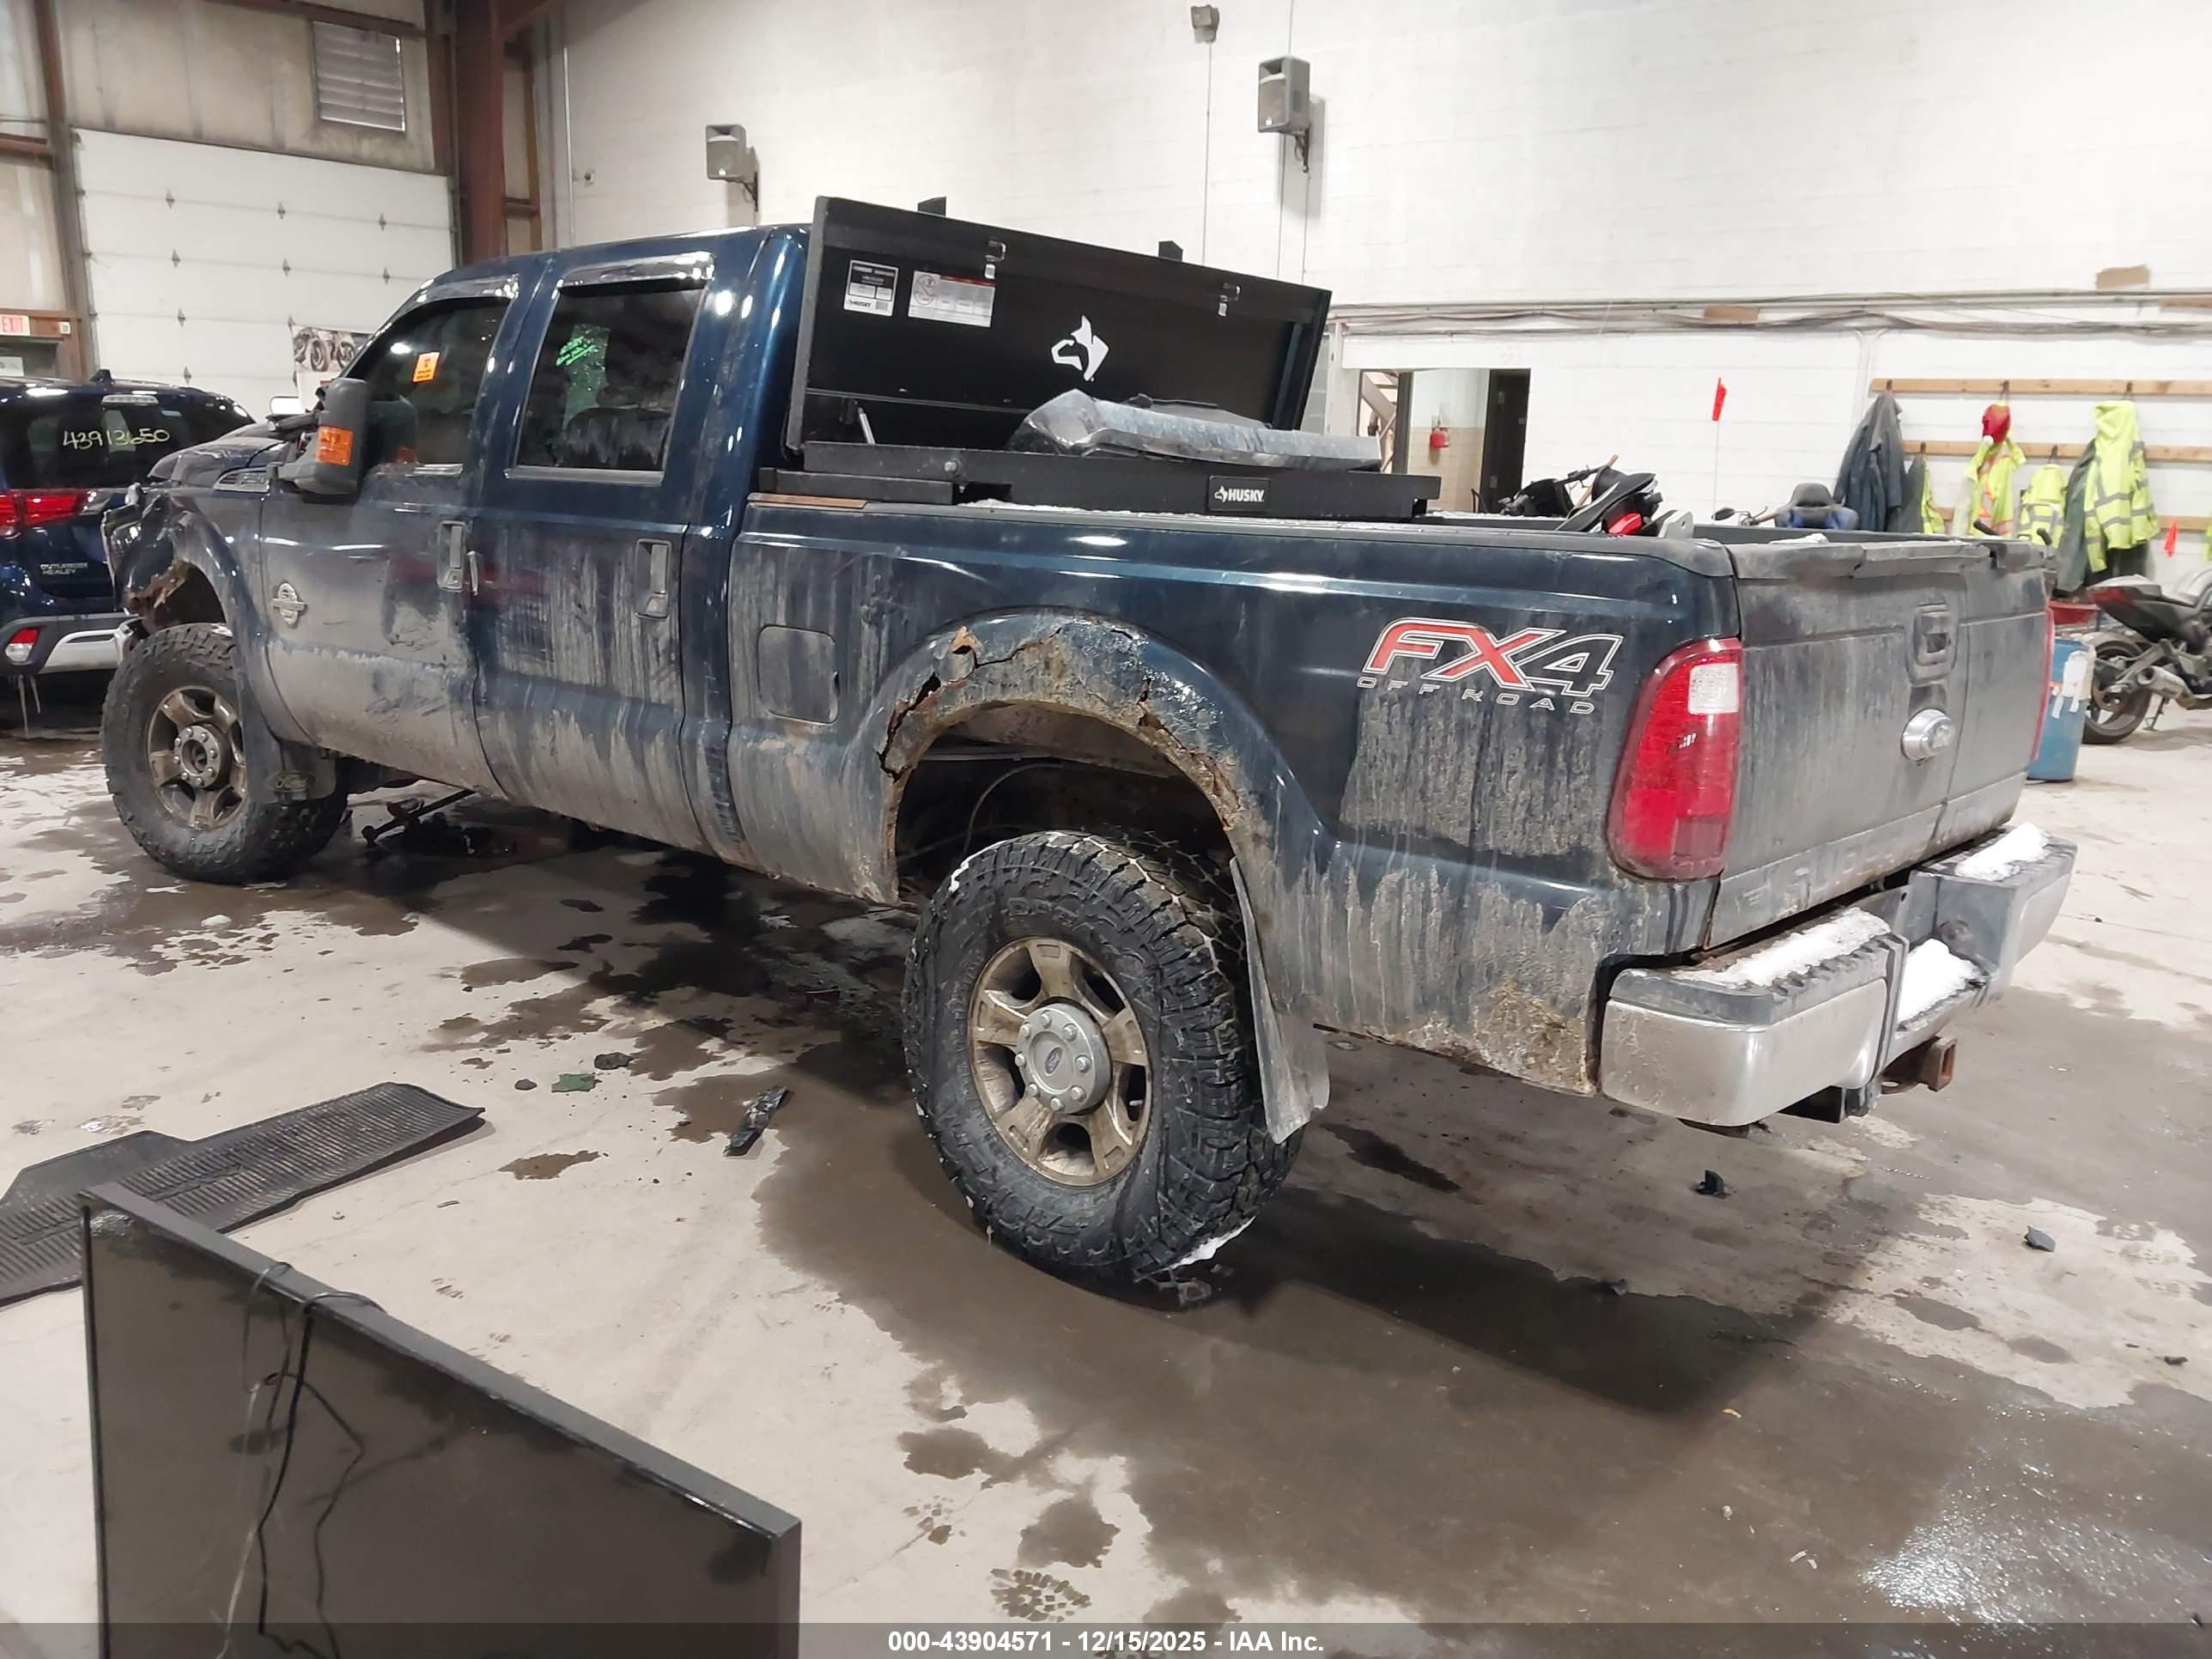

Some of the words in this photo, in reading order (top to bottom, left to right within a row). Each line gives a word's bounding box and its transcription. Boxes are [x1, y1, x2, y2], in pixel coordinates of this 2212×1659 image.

[63, 428, 170, 449] 43913650
[1228, 489, 1265, 502] HUSKY
[1362, 617, 1624, 697] FX4
[1357, 676, 1441, 695] OFF
[1462, 688, 1595, 714] ROAD
